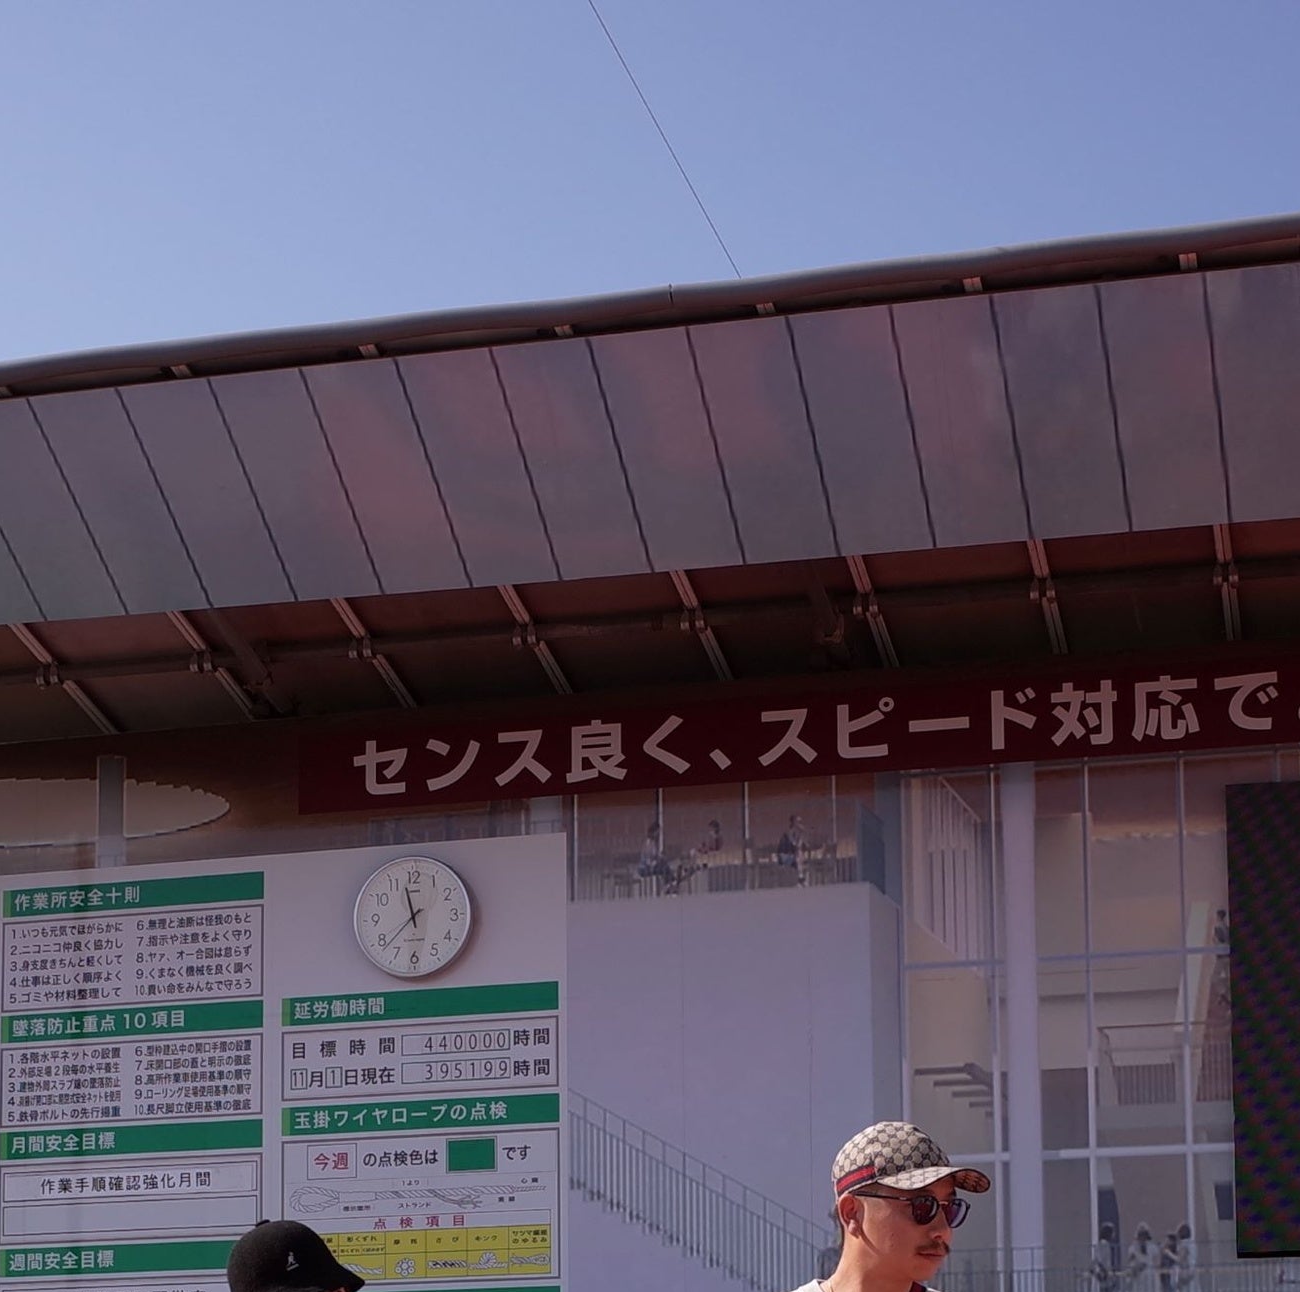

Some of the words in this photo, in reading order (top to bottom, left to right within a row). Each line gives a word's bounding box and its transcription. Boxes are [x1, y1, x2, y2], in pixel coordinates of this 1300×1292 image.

[388, 877, 400, 892] 11
[406, 870, 421, 885] 12
[430, 874, 437, 889] 1
[14, 885, 140, 912] 作業所安全十則
[375, 892, 390, 907] 10
[443, 887, 453, 902] 2
[370, 912, 381, 927] 9
[449, 907, 460, 922] 3
[377, 932, 388, 947] 8
[443, 928, 453, 942] 4
[393, 945, 402, 961] 7
[430, 942, 440, 957] 5
[409, 950, 420, 965] 6
[294, 997, 385, 1020] 延労働時間
[423, 1031, 507, 1052] 440000
[512, 1028, 551, 1047] 時間
[424, 1061, 508, 1081] 395199
[512, 1058, 551, 1077] 時間
[294, 1101, 508, 1129] 玉掛ワイヤロープの点検
[11, 1131, 116, 1154] 月間安全目標
[362, 1149, 439, 1168] の点検色は
[502, 1144, 532, 1161] です
[40, 1171, 212, 1195] 作業手順確認強化月間
[373, 1214, 466, 1230] 点検項目
[8, 1250, 115, 1272] 週間安全目標
